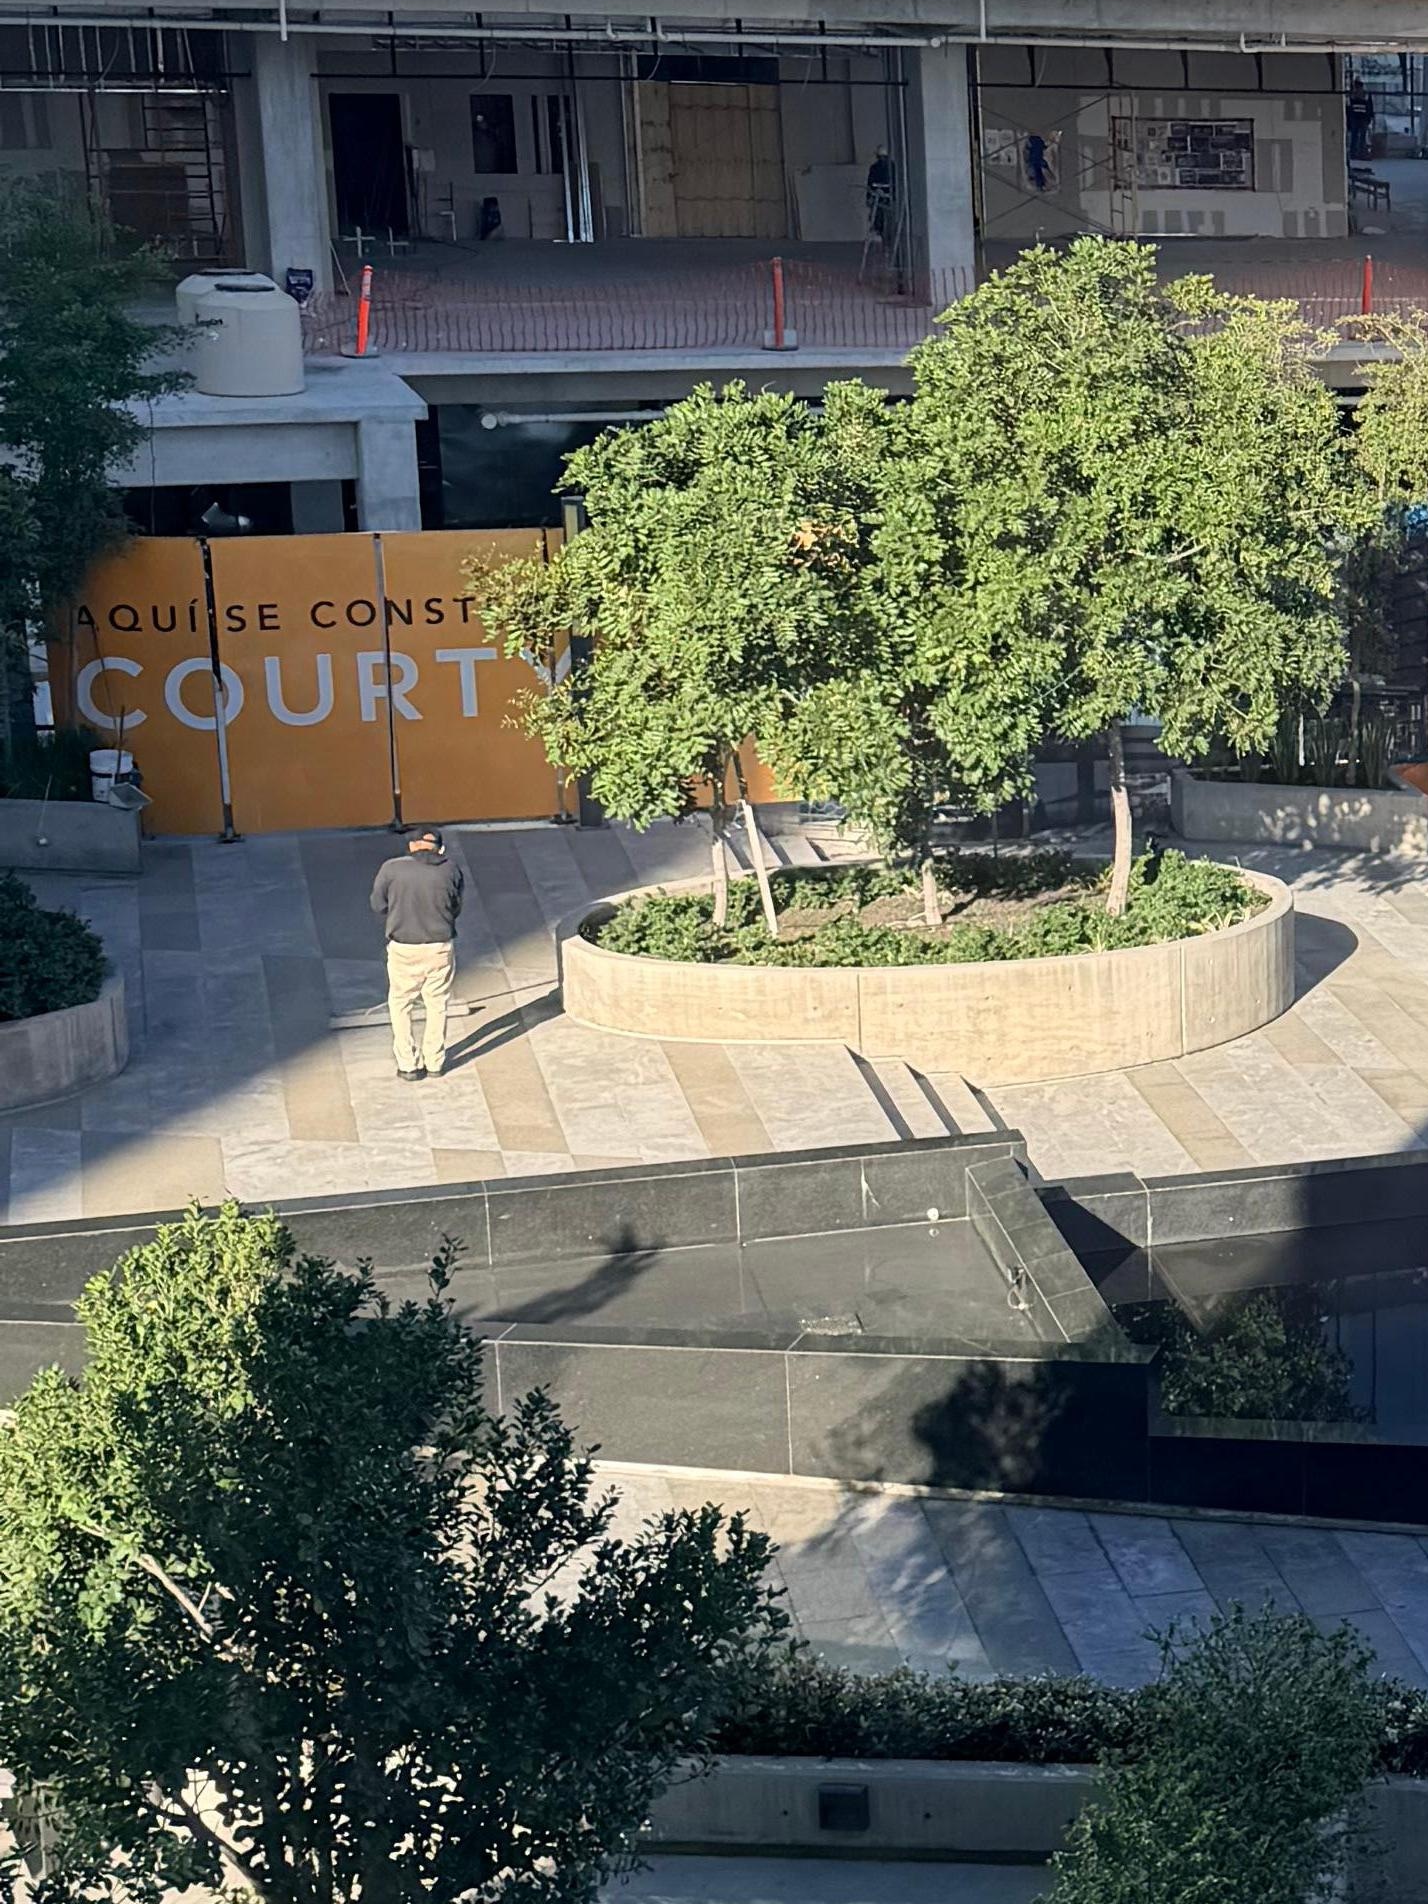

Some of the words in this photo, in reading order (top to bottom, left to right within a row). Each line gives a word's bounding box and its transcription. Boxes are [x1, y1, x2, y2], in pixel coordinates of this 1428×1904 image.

[77, 598, 203, 633] AQUÍ
[225, 603, 280, 633] SE
[310, 596, 477, 629] CONST
